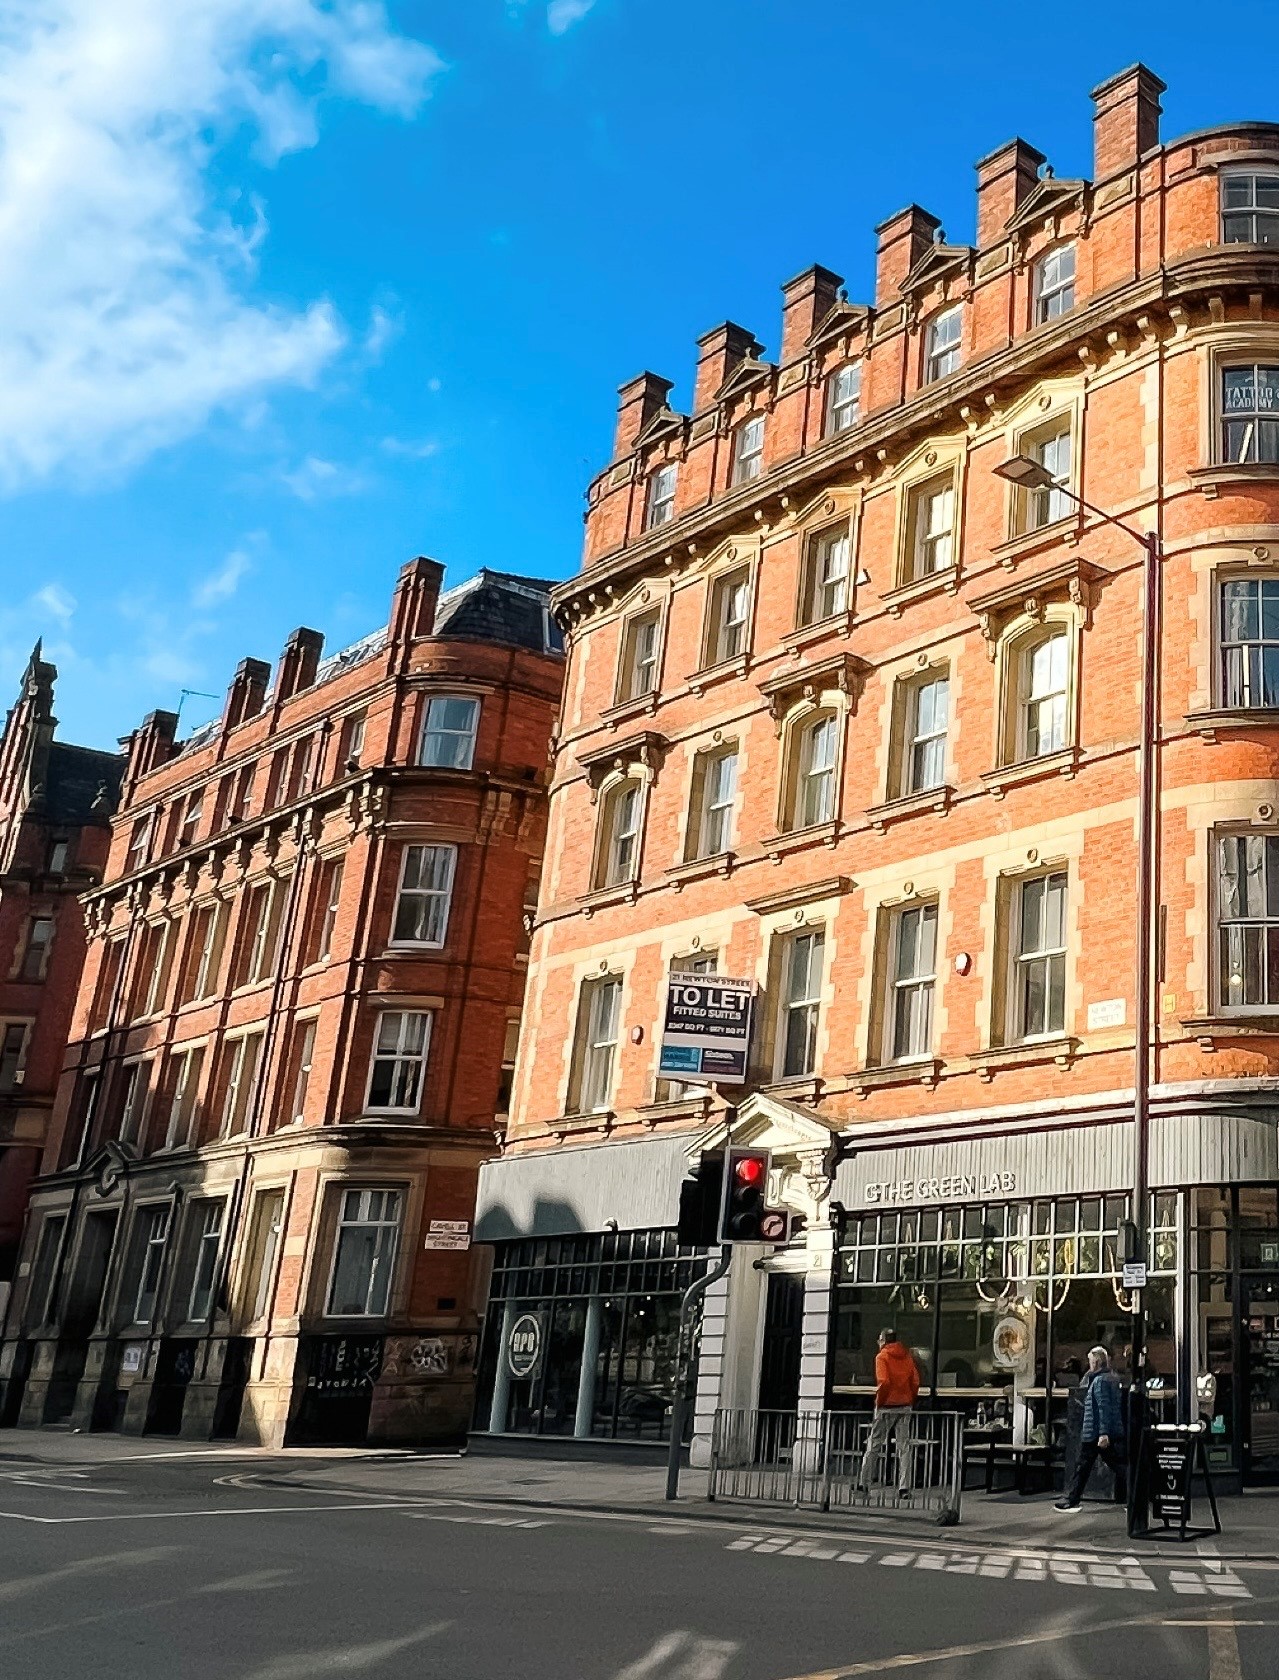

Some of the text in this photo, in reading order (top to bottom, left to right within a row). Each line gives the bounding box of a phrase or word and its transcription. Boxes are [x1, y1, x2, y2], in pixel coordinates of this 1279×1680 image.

[669, 985, 750, 1011] TO LET
[673, 1005, 742, 1020] FITTED SUITES
[880, 1180, 914, 1201] THE
[917, 1174, 976, 1199] GREEN
[979, 1171, 1016, 1194] LAB
